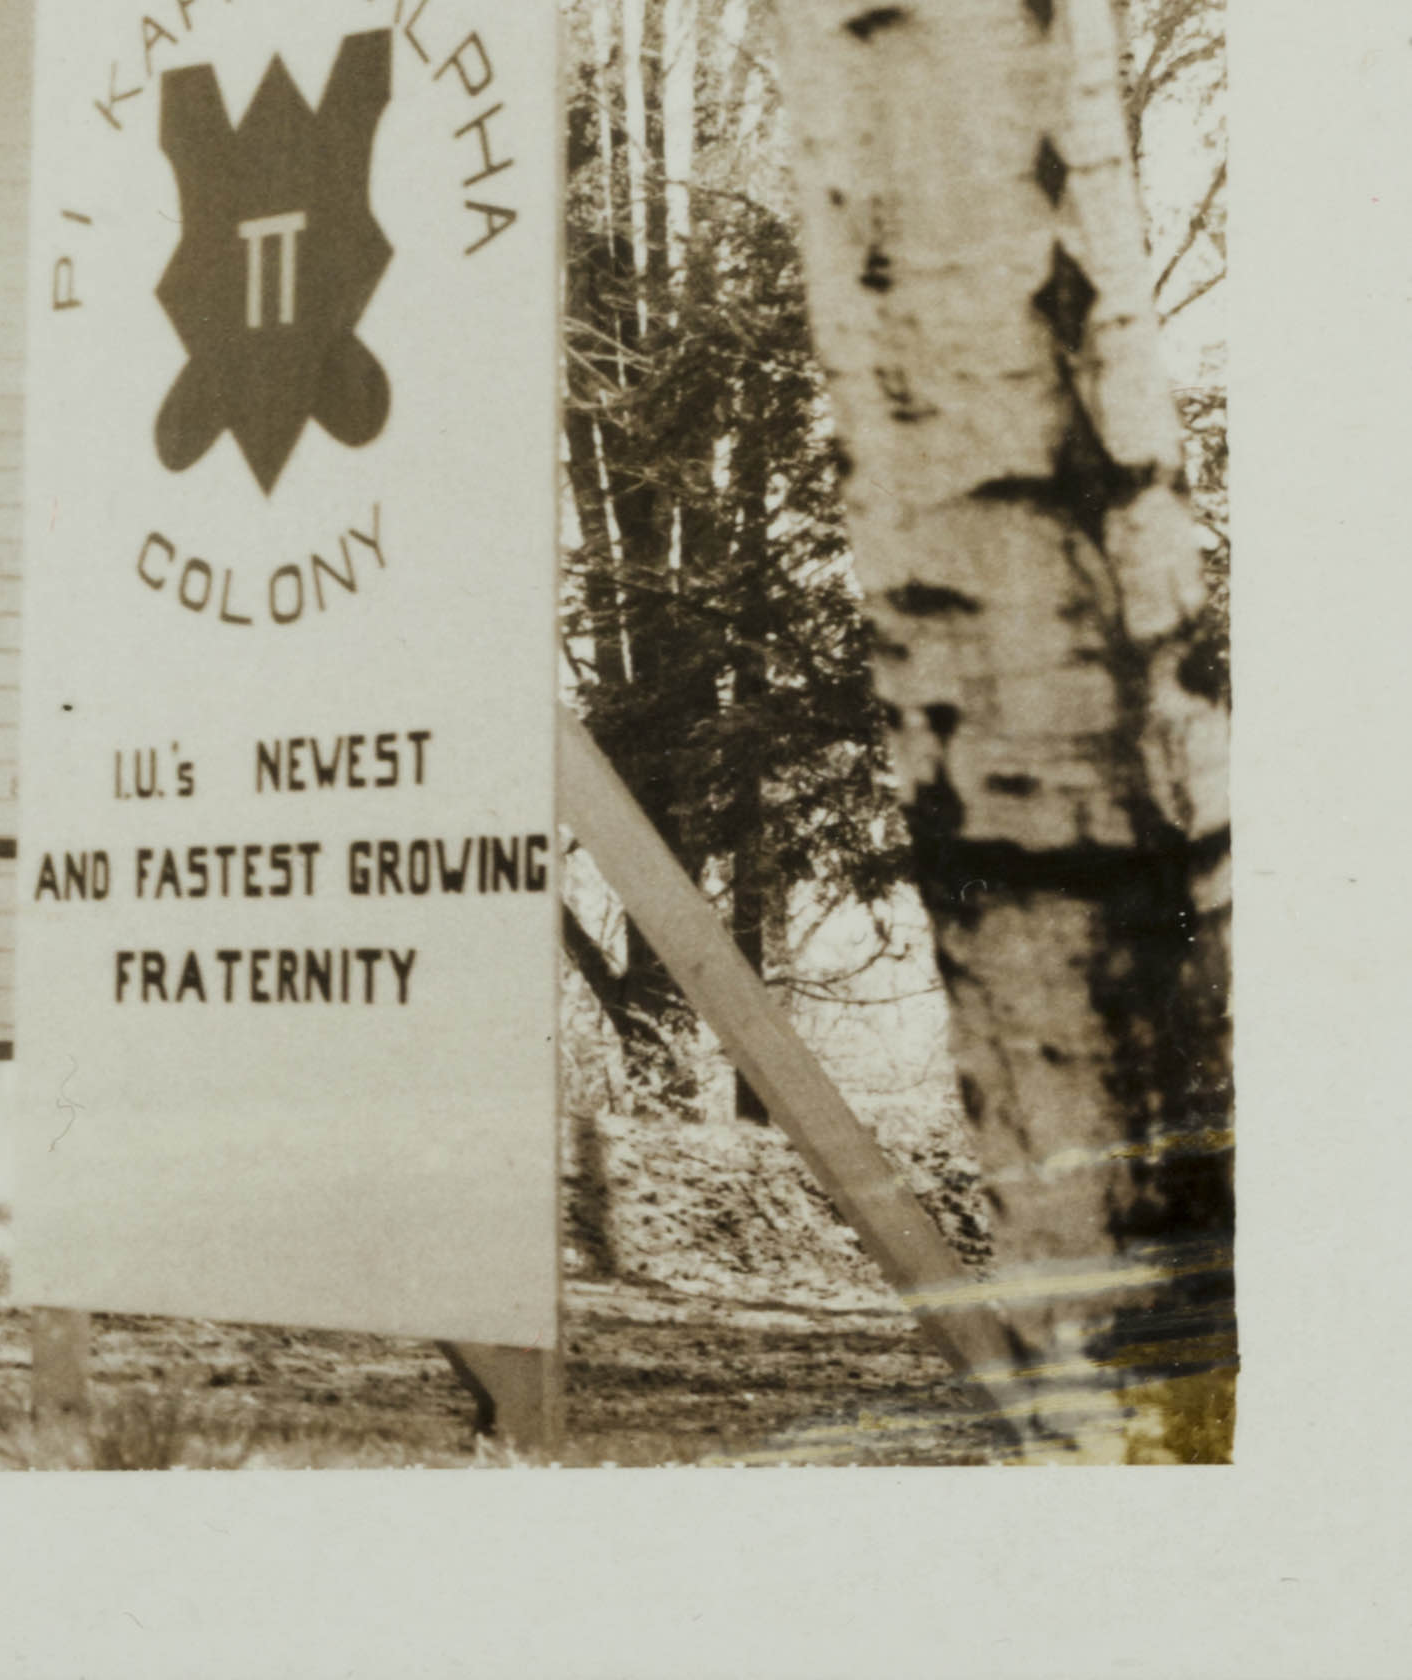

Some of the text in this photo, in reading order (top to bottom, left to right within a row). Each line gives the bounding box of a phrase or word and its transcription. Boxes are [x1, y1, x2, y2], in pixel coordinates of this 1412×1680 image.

[51, 208, 94, 311] PI
[136, 501, 388, 625] COLONY
[255, 730, 432, 793] NEWEST
[34, 834, 549, 902] AND FASTEST GROWING
[114, 948, 418, 1005] FRATERNITY
